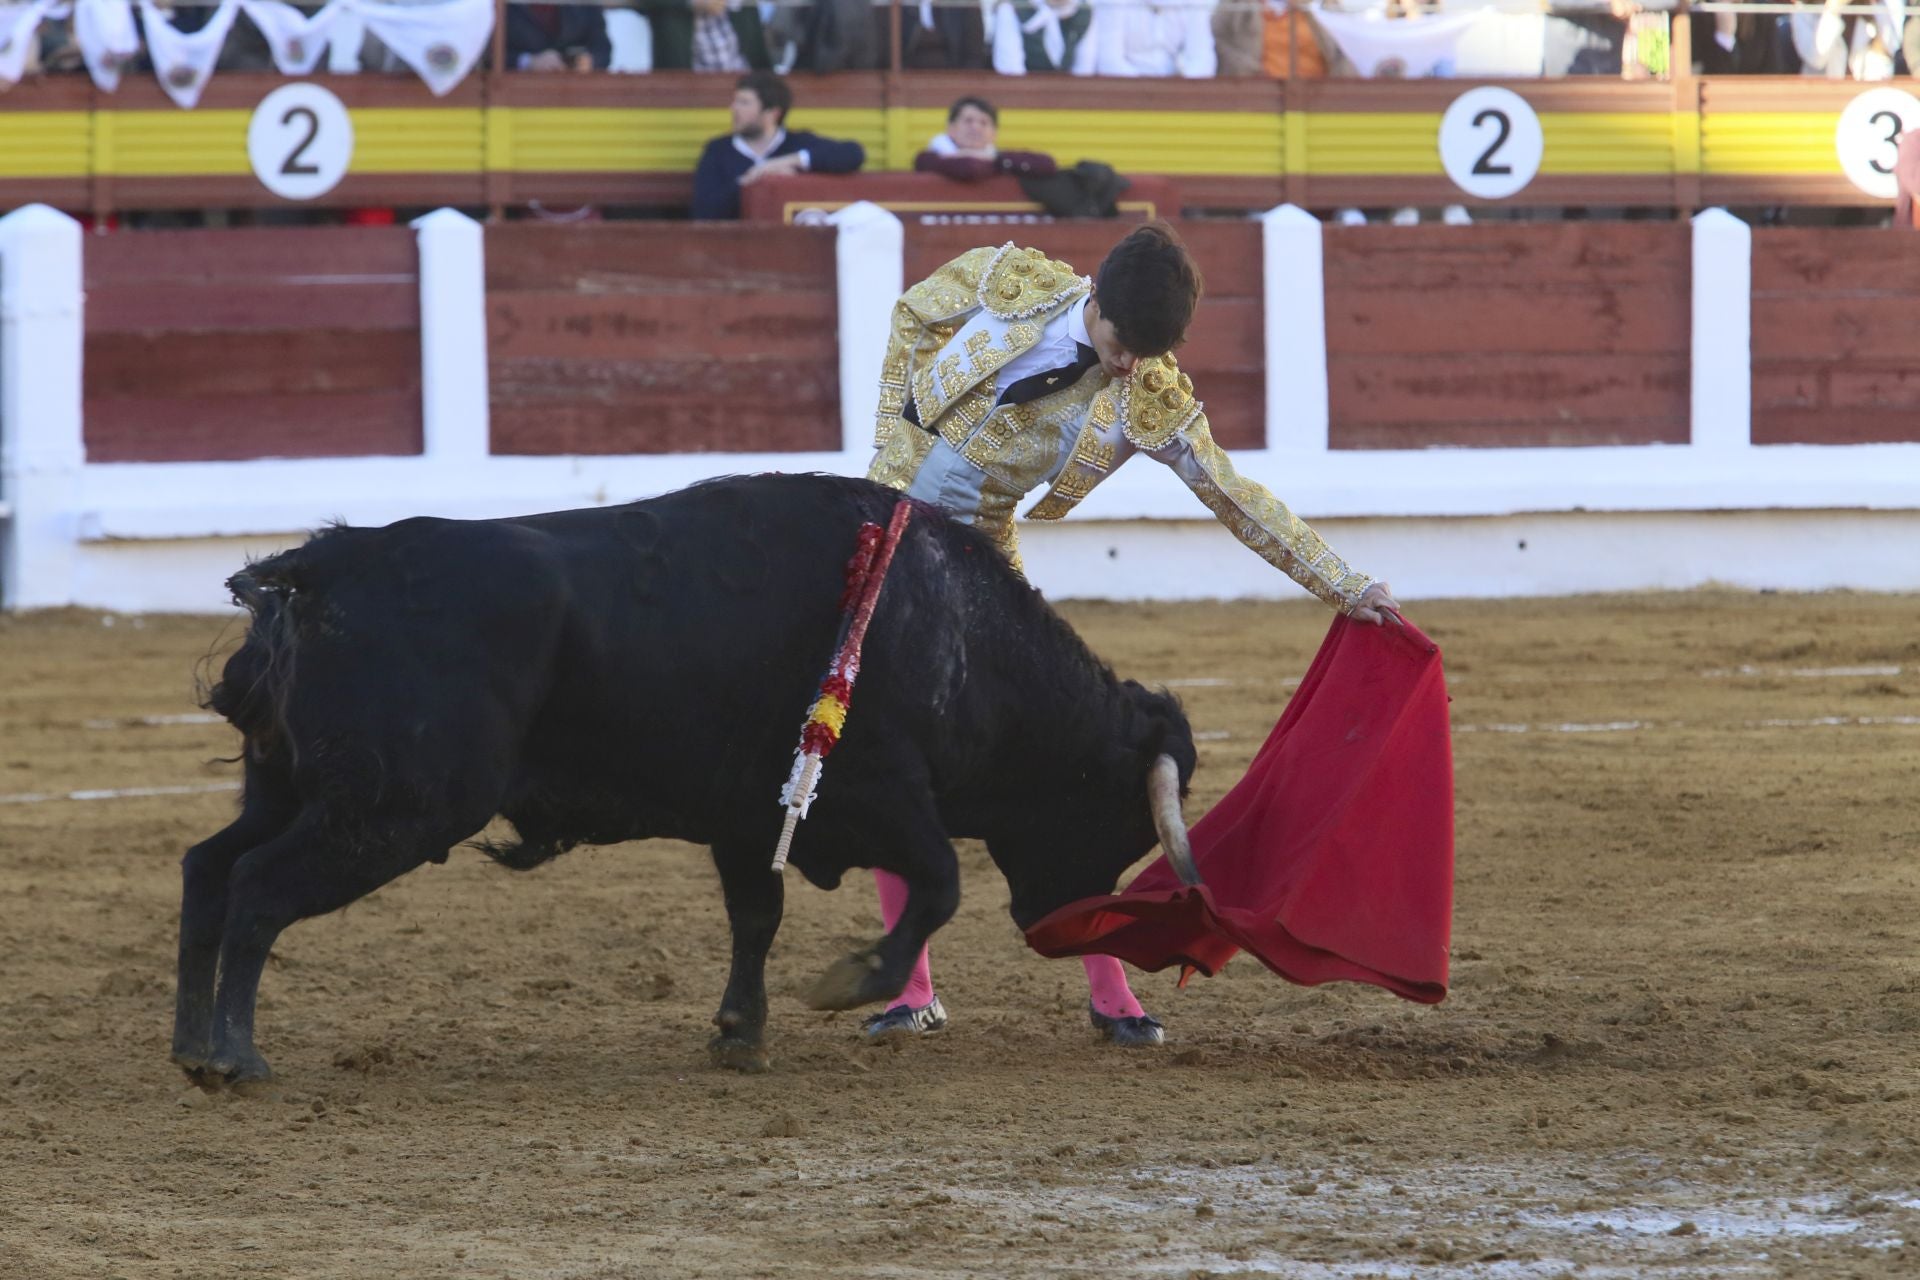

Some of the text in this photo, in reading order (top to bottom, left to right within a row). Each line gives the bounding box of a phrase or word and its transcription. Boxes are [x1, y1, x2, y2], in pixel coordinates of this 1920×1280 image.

[279, 106, 320, 176] 2
[1471, 109, 1512, 176] 2
[1869, 110, 1903, 174] 3
